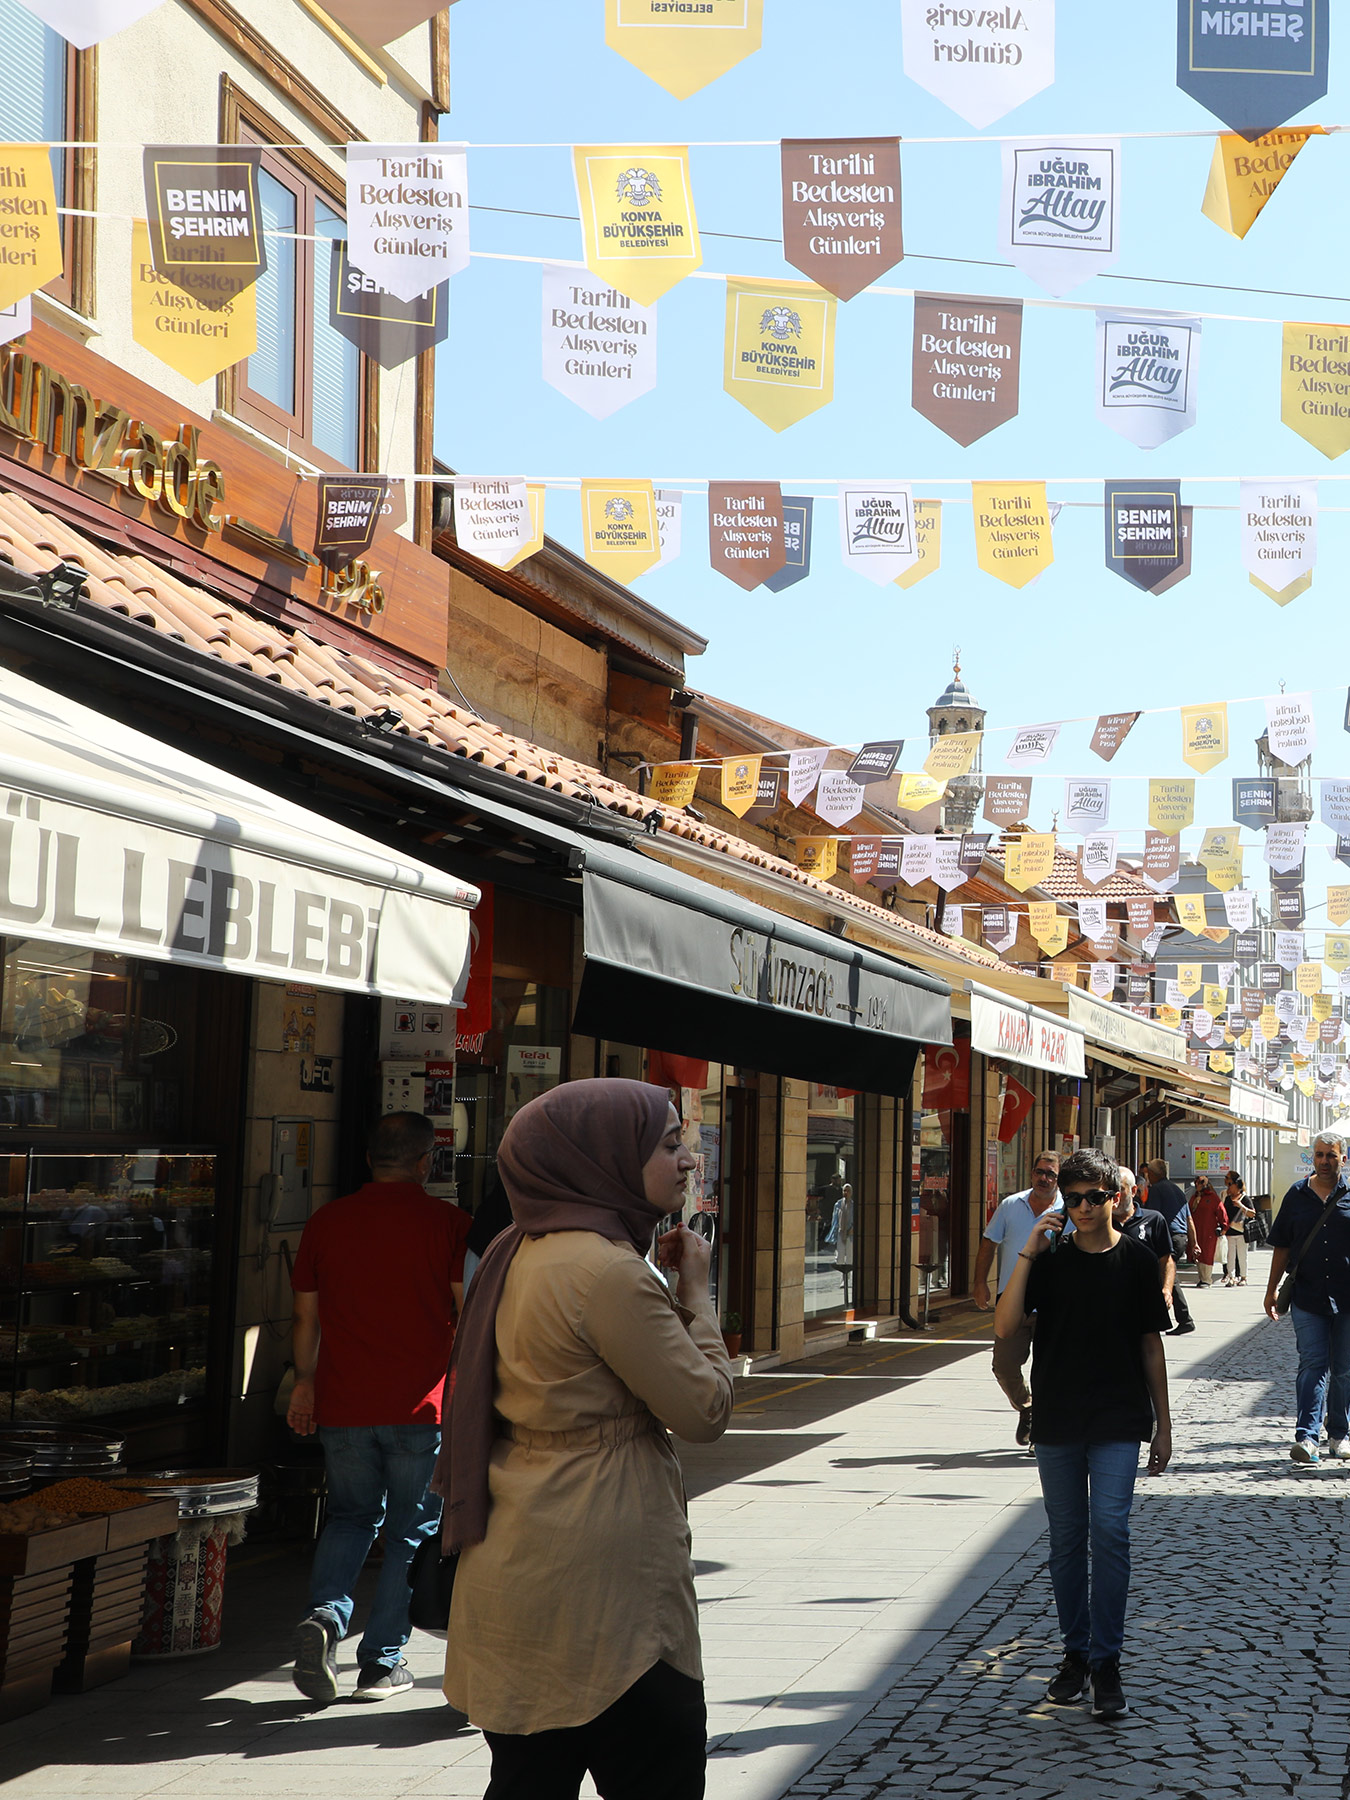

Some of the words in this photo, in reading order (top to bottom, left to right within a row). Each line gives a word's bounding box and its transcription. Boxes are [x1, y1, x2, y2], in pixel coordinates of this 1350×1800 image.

[376, 157, 443, 180] Tarihi
[808, 152, 875, 175] Tarihi
[1039, 156, 1090, 176] UĞUR
[359, 182, 462, 209] Bedesten
[792, 179, 894, 203] Bedesten
[620, 211, 663, 223] KONYA
[802, 207, 885, 231] Alışveriş
[1018, 187, 1107, 230] Altay
[369, 209, 453, 236] Alışveriş
[603, 221, 684, 240] BÜYÜKŞEHİR
[373, 237, 447, 259] Günleri
[619, 237, 669, 248] BELEDİYESİ
[809, 235, 881, 255] Günleri
[568, 286, 631, 310] Tarihi
[155, 315, 229, 339] Günleri
[551, 308, 647, 336] Bedesten
[937, 312, 997, 335] Tarihi
[560, 333, 638, 359] Alışveriş
[761, 342, 798, 354] KONYA
[921, 333, 1012, 360] Bedesten
[1127, 330, 1170, 348] UĞUR
[564, 358, 632, 379] Günleri
[741, 351, 815, 370] BÜYÜKŞEHİR
[928, 358, 1002, 383] Alışveriş
[756, 365, 800, 378] BELEDİYESİ
[1109, 357, 1183, 391] Altay
[932, 382, 996, 403] Günleri
[469, 480, 510, 495] Tarihi
[460, 497, 524, 511] Bedesten
[862, 499, 893, 511] UĞUR
[467, 512, 520, 528] Alışveriş
[852, 516, 905, 544] Altay
[472, 526, 520, 540] Günleri
[518, 1050, 551, 1061] Tefal
